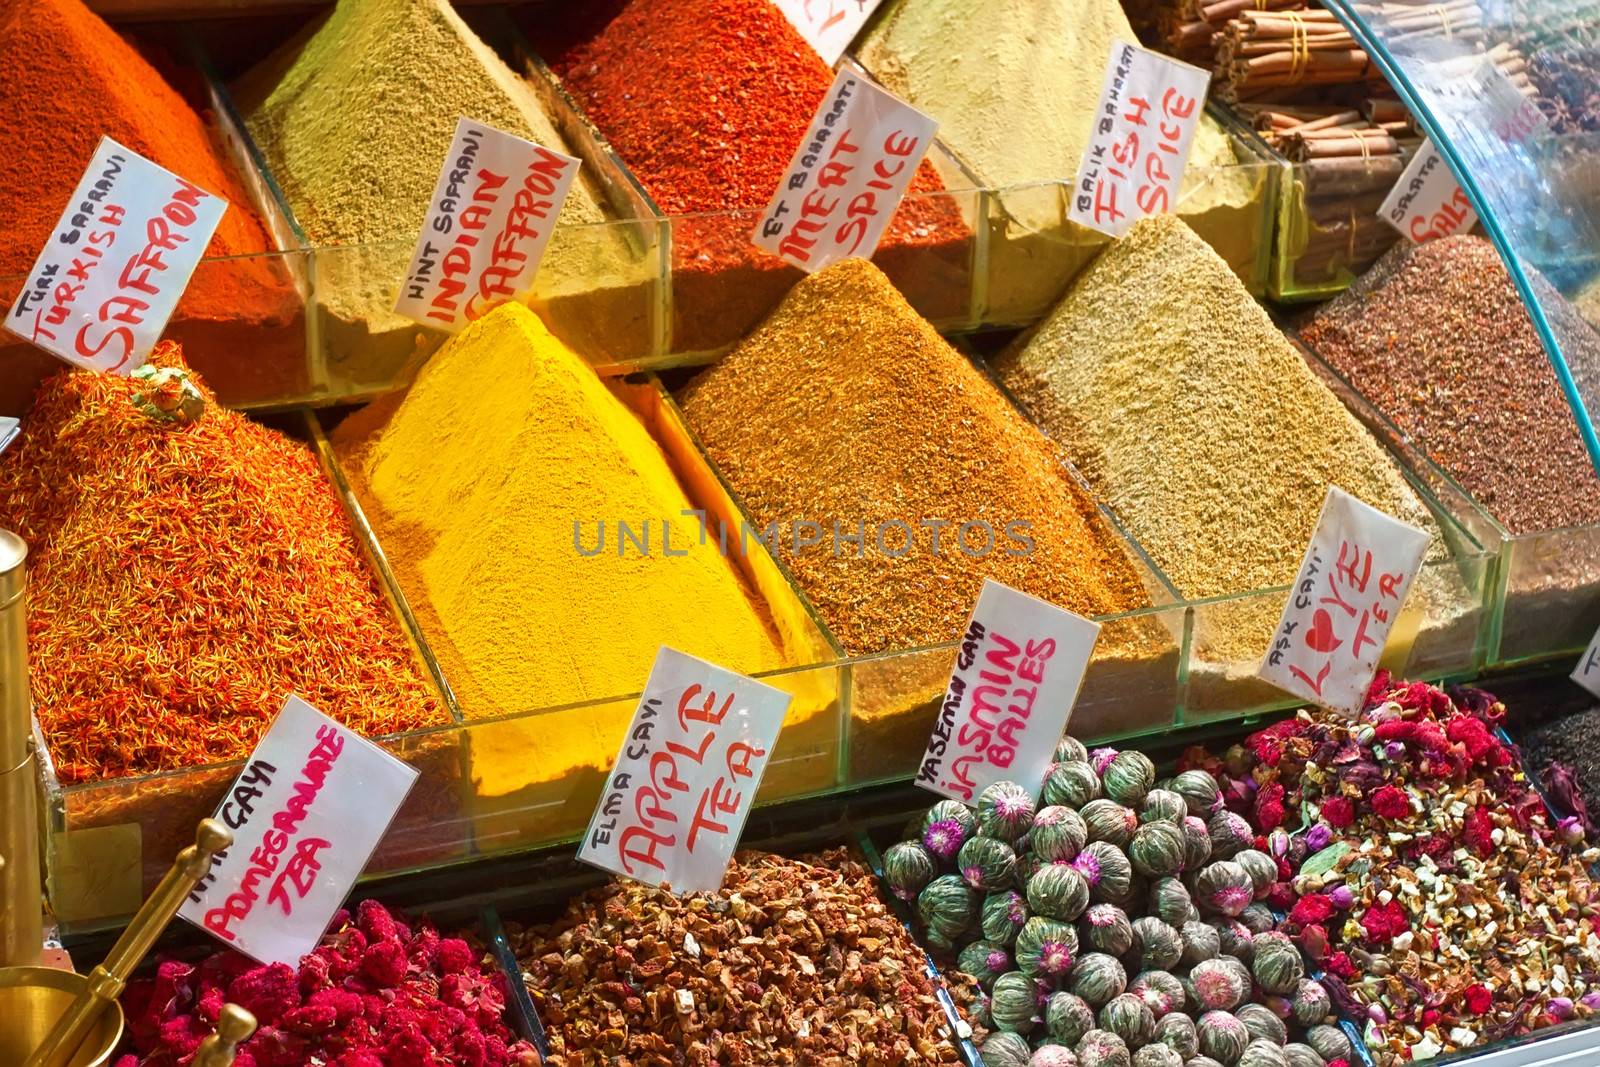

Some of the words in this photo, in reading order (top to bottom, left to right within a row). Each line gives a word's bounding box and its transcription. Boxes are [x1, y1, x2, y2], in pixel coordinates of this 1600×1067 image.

[779, 129, 859, 262] MEAT
[835, 130, 918, 256] SPICE
[1094, 97, 1151, 224] FISH
[1136, 88, 1195, 214] SPICE
[32, 205, 126, 343] TURKISH
[75, 178, 209, 372] SAFFRON
[427, 169, 509, 323] INDIAN
[763, 200, 789, 238] ET
[618, 683, 735, 874] APPLE
[686, 742, 766, 854] TEA
[267, 837, 332, 916] TEA
